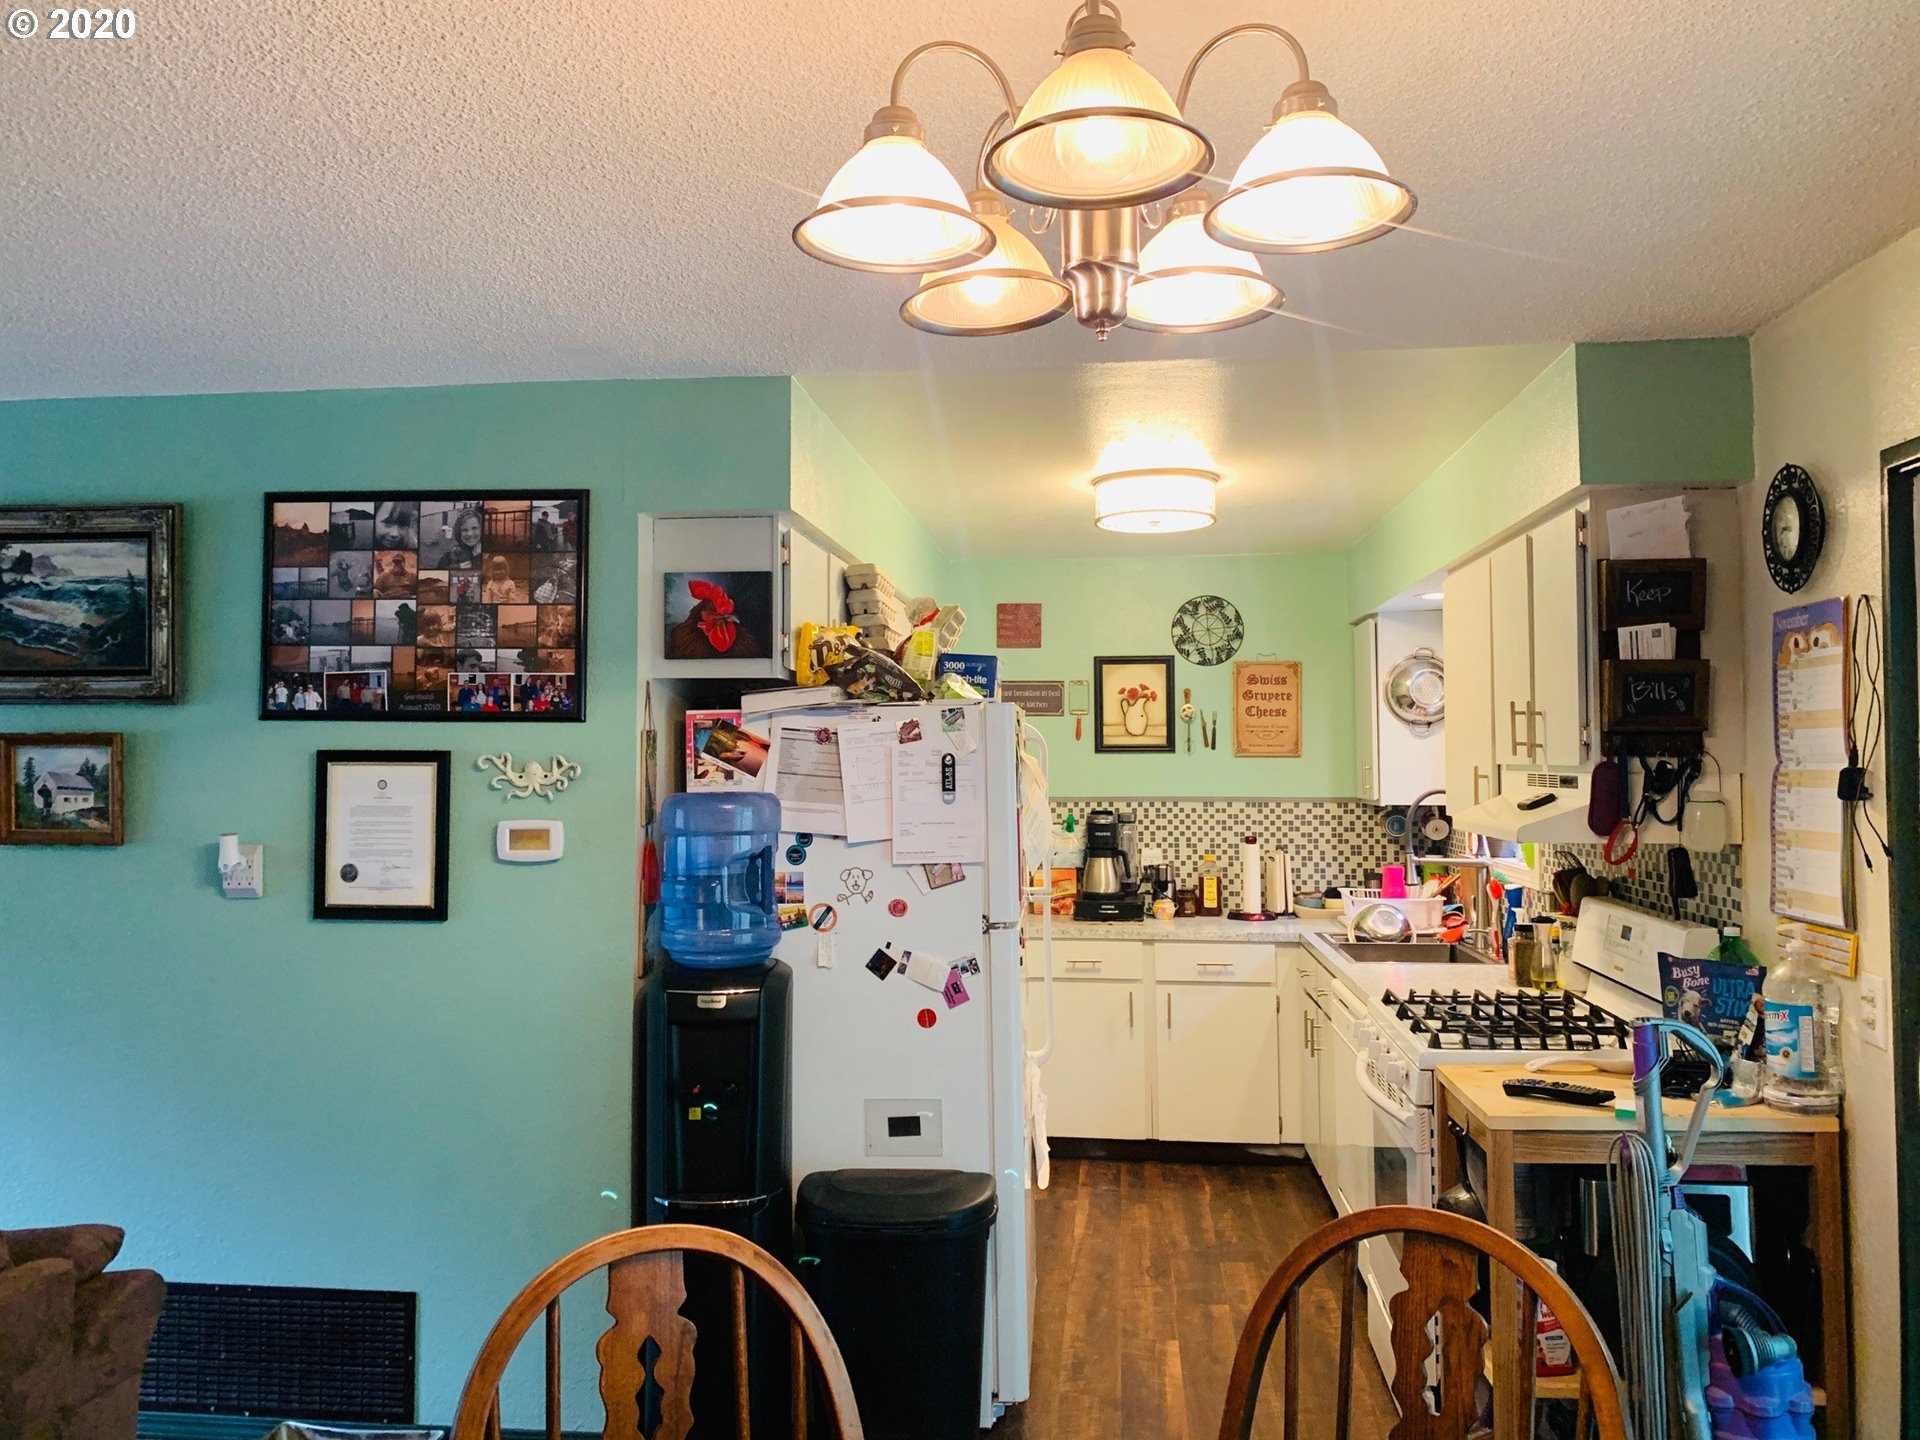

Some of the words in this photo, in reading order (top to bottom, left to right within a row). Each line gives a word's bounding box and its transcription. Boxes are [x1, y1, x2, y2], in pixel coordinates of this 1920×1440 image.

[1626, 579, 1672, 607] Keep
[943, 661, 966, 670] 3000
[1246, 674, 1288, 686] Swiss
[1242, 689, 1293, 703] Gruyere
[1245, 705, 1288, 719] Cheese
[945, 767, 953, 790] ATLAS
[1672, 965, 1700, 979] Busy
[1682, 976, 1710, 988] Bone
